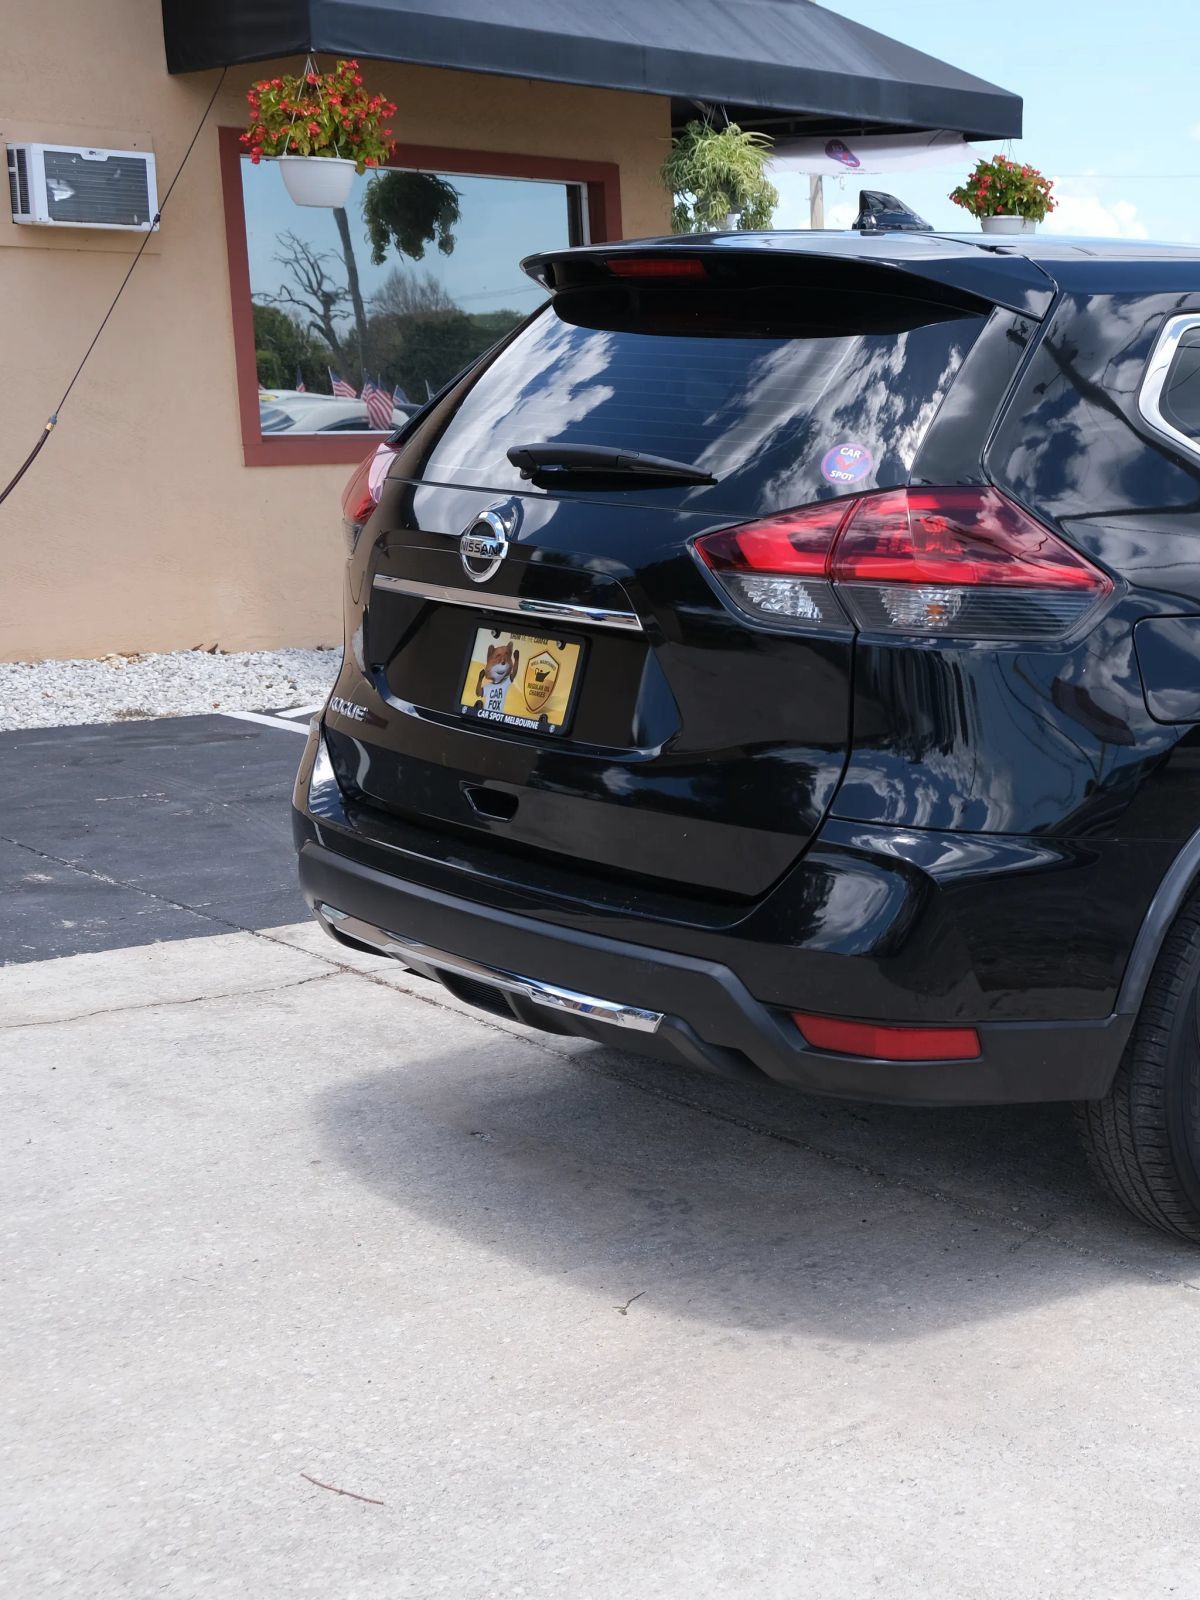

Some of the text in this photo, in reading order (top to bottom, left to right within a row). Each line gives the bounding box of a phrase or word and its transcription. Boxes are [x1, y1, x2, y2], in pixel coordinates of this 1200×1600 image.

[840, 447, 861, 459] CAR
[829, 470, 855, 481] SPOT
[461, 541, 499, 556] NISSAN
[489, 688, 502, 699] CAR
[487, 699, 502, 711] FOX
[477, 709, 540, 730] CAR SPOT MELBOURNE
